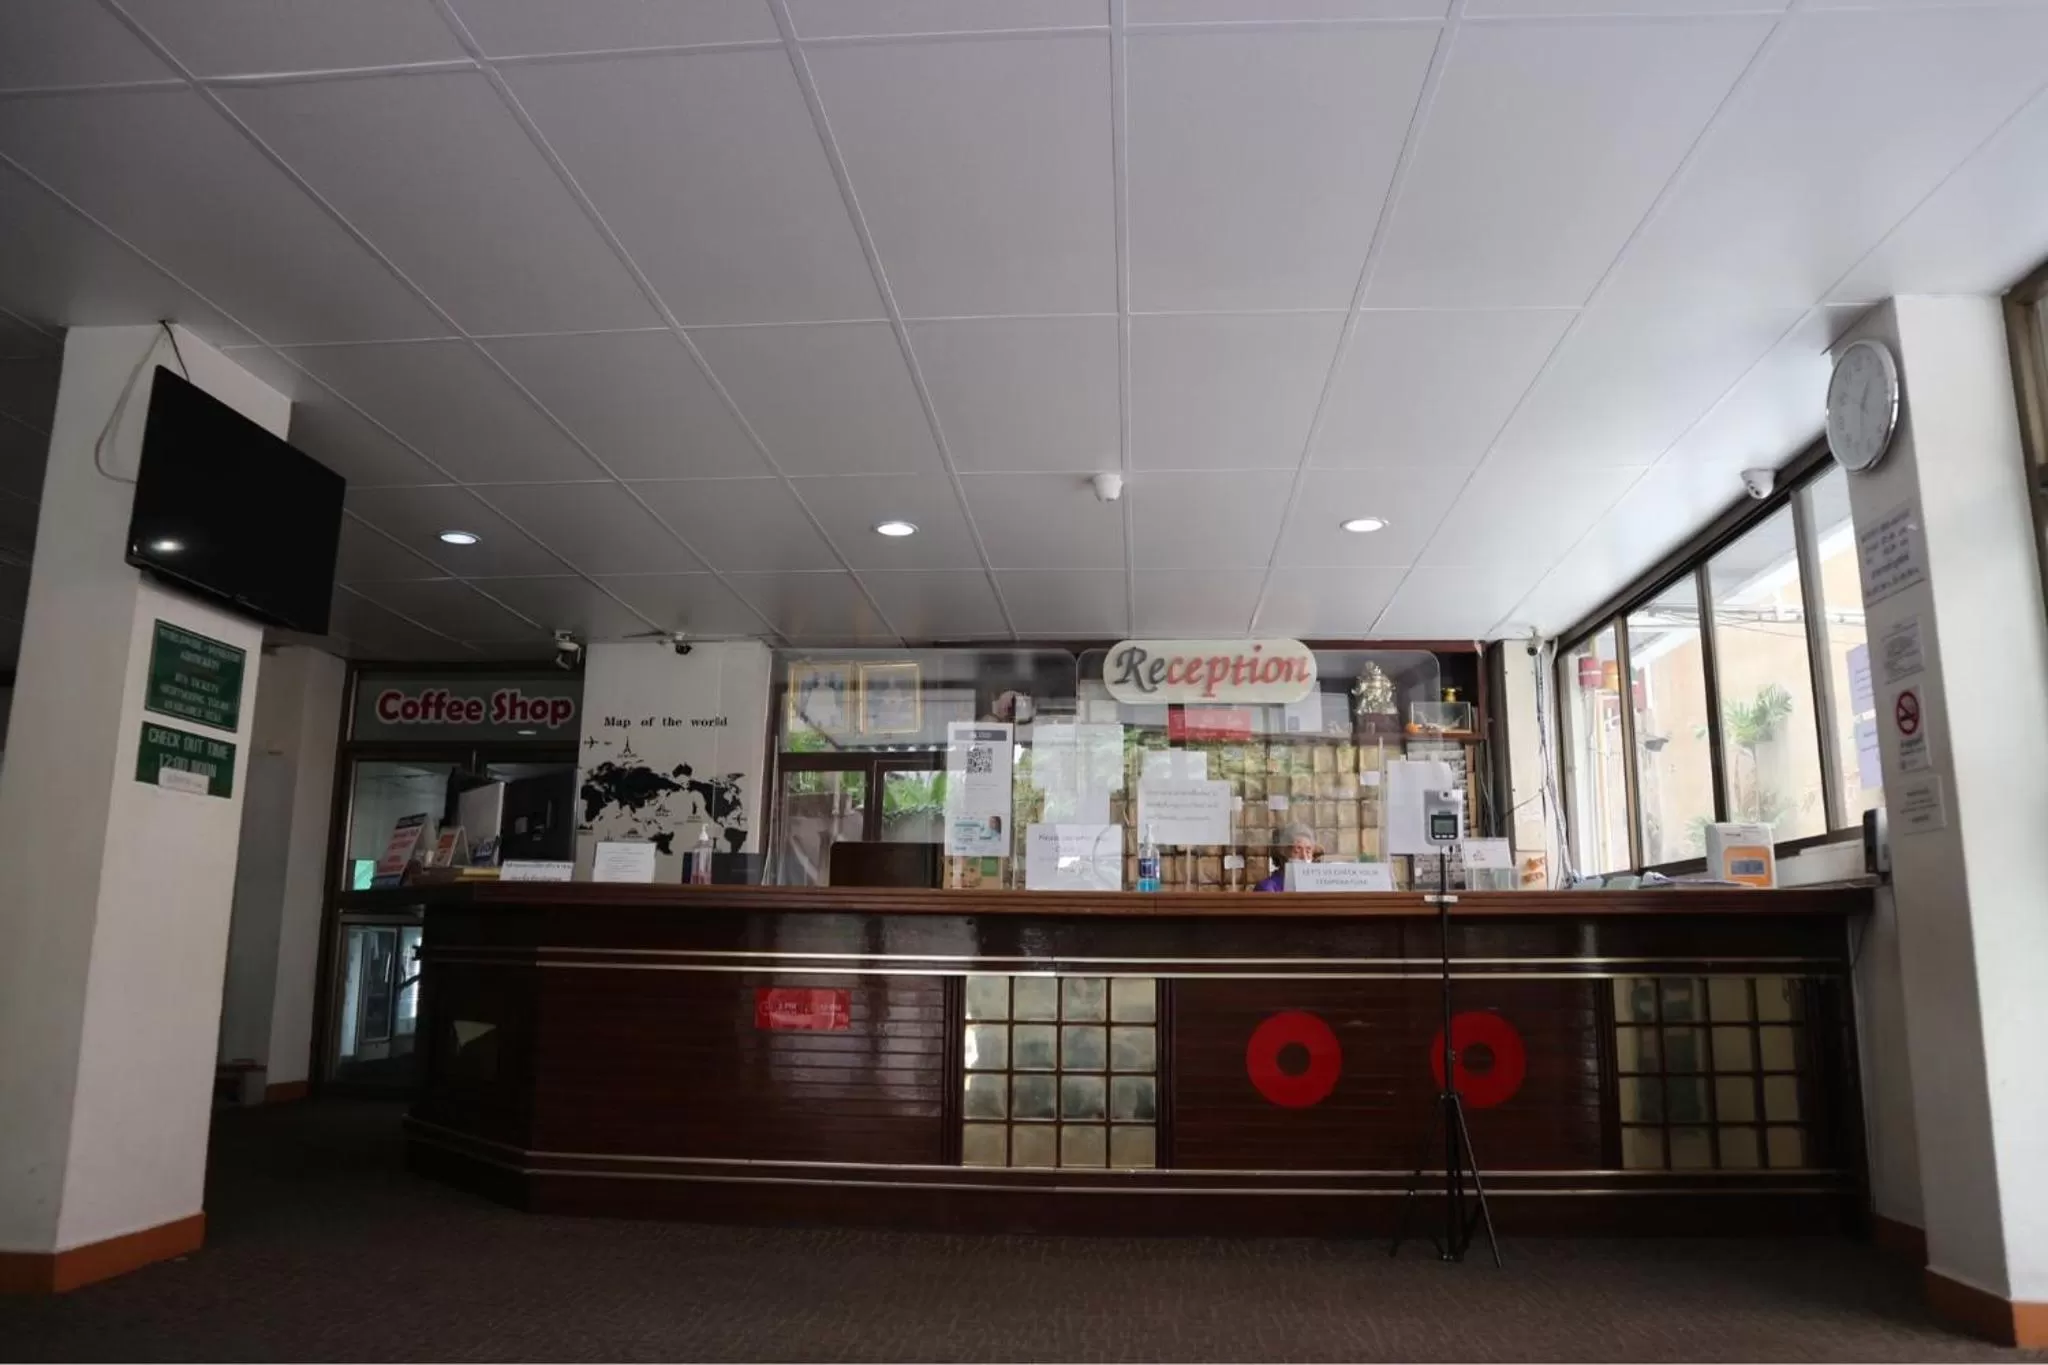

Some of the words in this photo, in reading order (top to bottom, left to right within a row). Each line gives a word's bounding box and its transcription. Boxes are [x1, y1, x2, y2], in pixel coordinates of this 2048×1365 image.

[1114, 645, 1310, 698] Reception
[377, 690, 484, 723] Coffee
[491, 690, 575, 727] Shop
[604, 716, 631, 728] Map
[641, 716, 655, 727] of
[662, 716, 682, 726] the
[691, 716, 727, 726] world
[148, 728, 180, 748] CHECK
[183, 735, 204, 754] OUT
[207, 741, 229, 759] TIME
